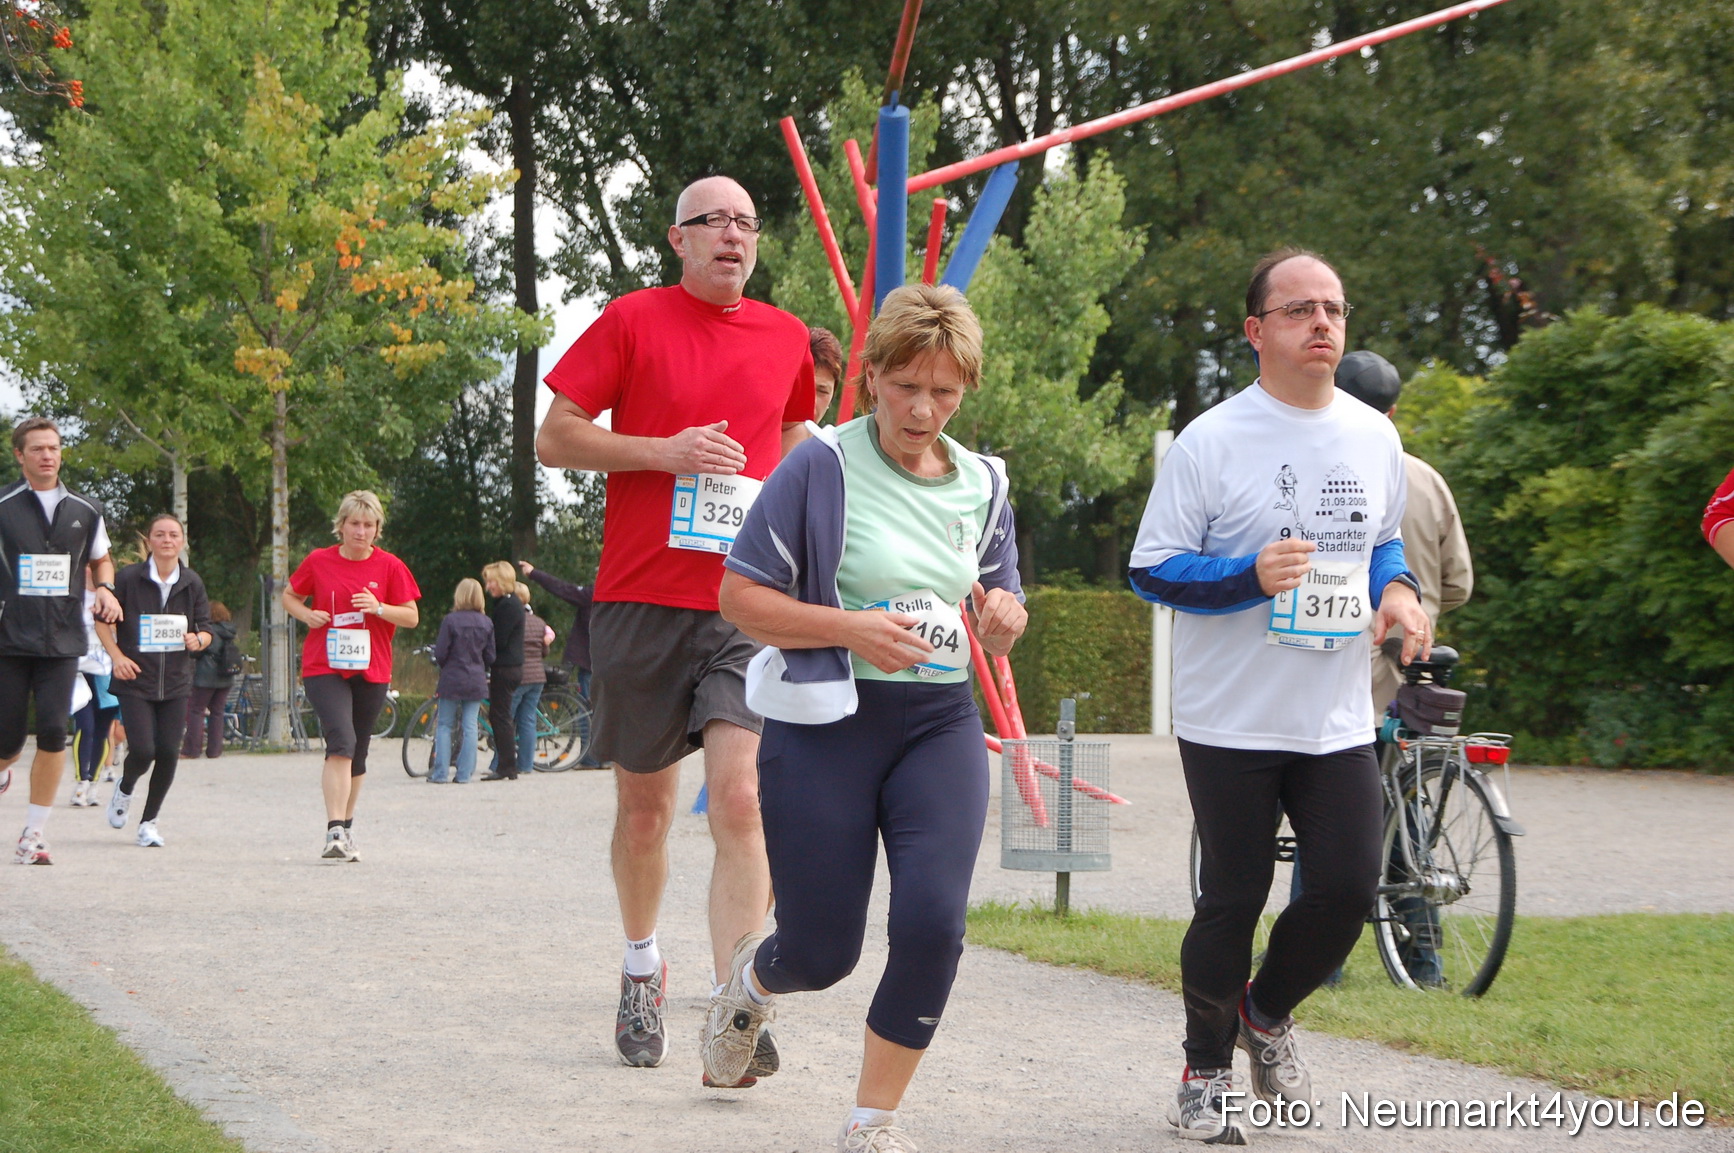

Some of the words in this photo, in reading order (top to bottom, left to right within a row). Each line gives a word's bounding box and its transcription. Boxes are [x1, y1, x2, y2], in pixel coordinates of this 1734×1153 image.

[704, 477, 737, 495] Peter
[1320, 497, 1368, 507] 21.09.2008
[702, 501, 750, 527] 329
[1301, 529, 1367, 541] Neumarkter
[1317, 541, 1367, 553] Stadtlauf
[36, 570, 65, 581] 2743
[895, 598, 932, 613] Stilla
[1305, 594, 1362, 619] 3173
[154, 628, 182, 639] 2838
[903, 622, 959, 653] 164
[339, 644, 366, 655] 2341
